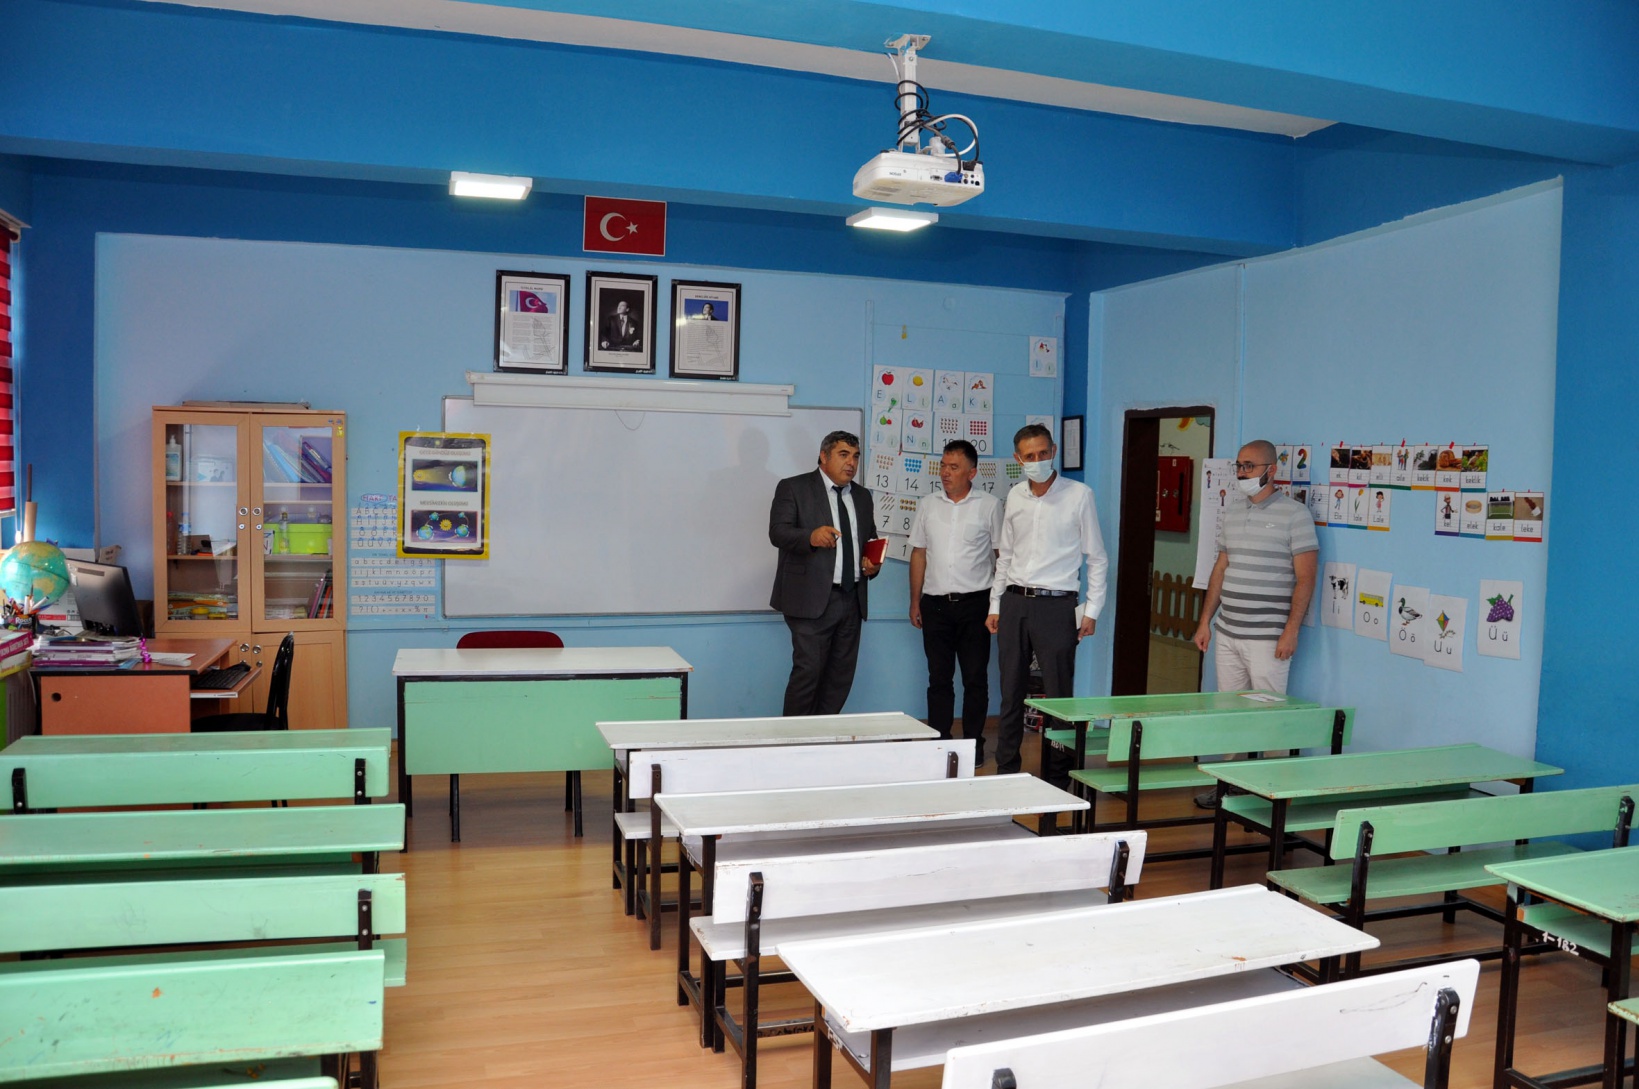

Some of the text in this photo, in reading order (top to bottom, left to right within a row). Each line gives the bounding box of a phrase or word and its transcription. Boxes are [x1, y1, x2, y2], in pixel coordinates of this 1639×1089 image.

[938, 395, 945, 404] A
[969, 398, 975, 406] K
[906, 435, 914, 444] N
[876, 474, 889, 488] 13
[904, 477, 919, 491] 14
[982, 481, 994, 494] 17
[882, 515, 890, 528] 7
[903, 517, 911, 530] 8
[1363, 611, 1371, 623] O
[1399, 627, 1407, 641] Ö
[1488, 625, 1508, 642] Ü ü
[1434, 640, 1452, 655] U u
